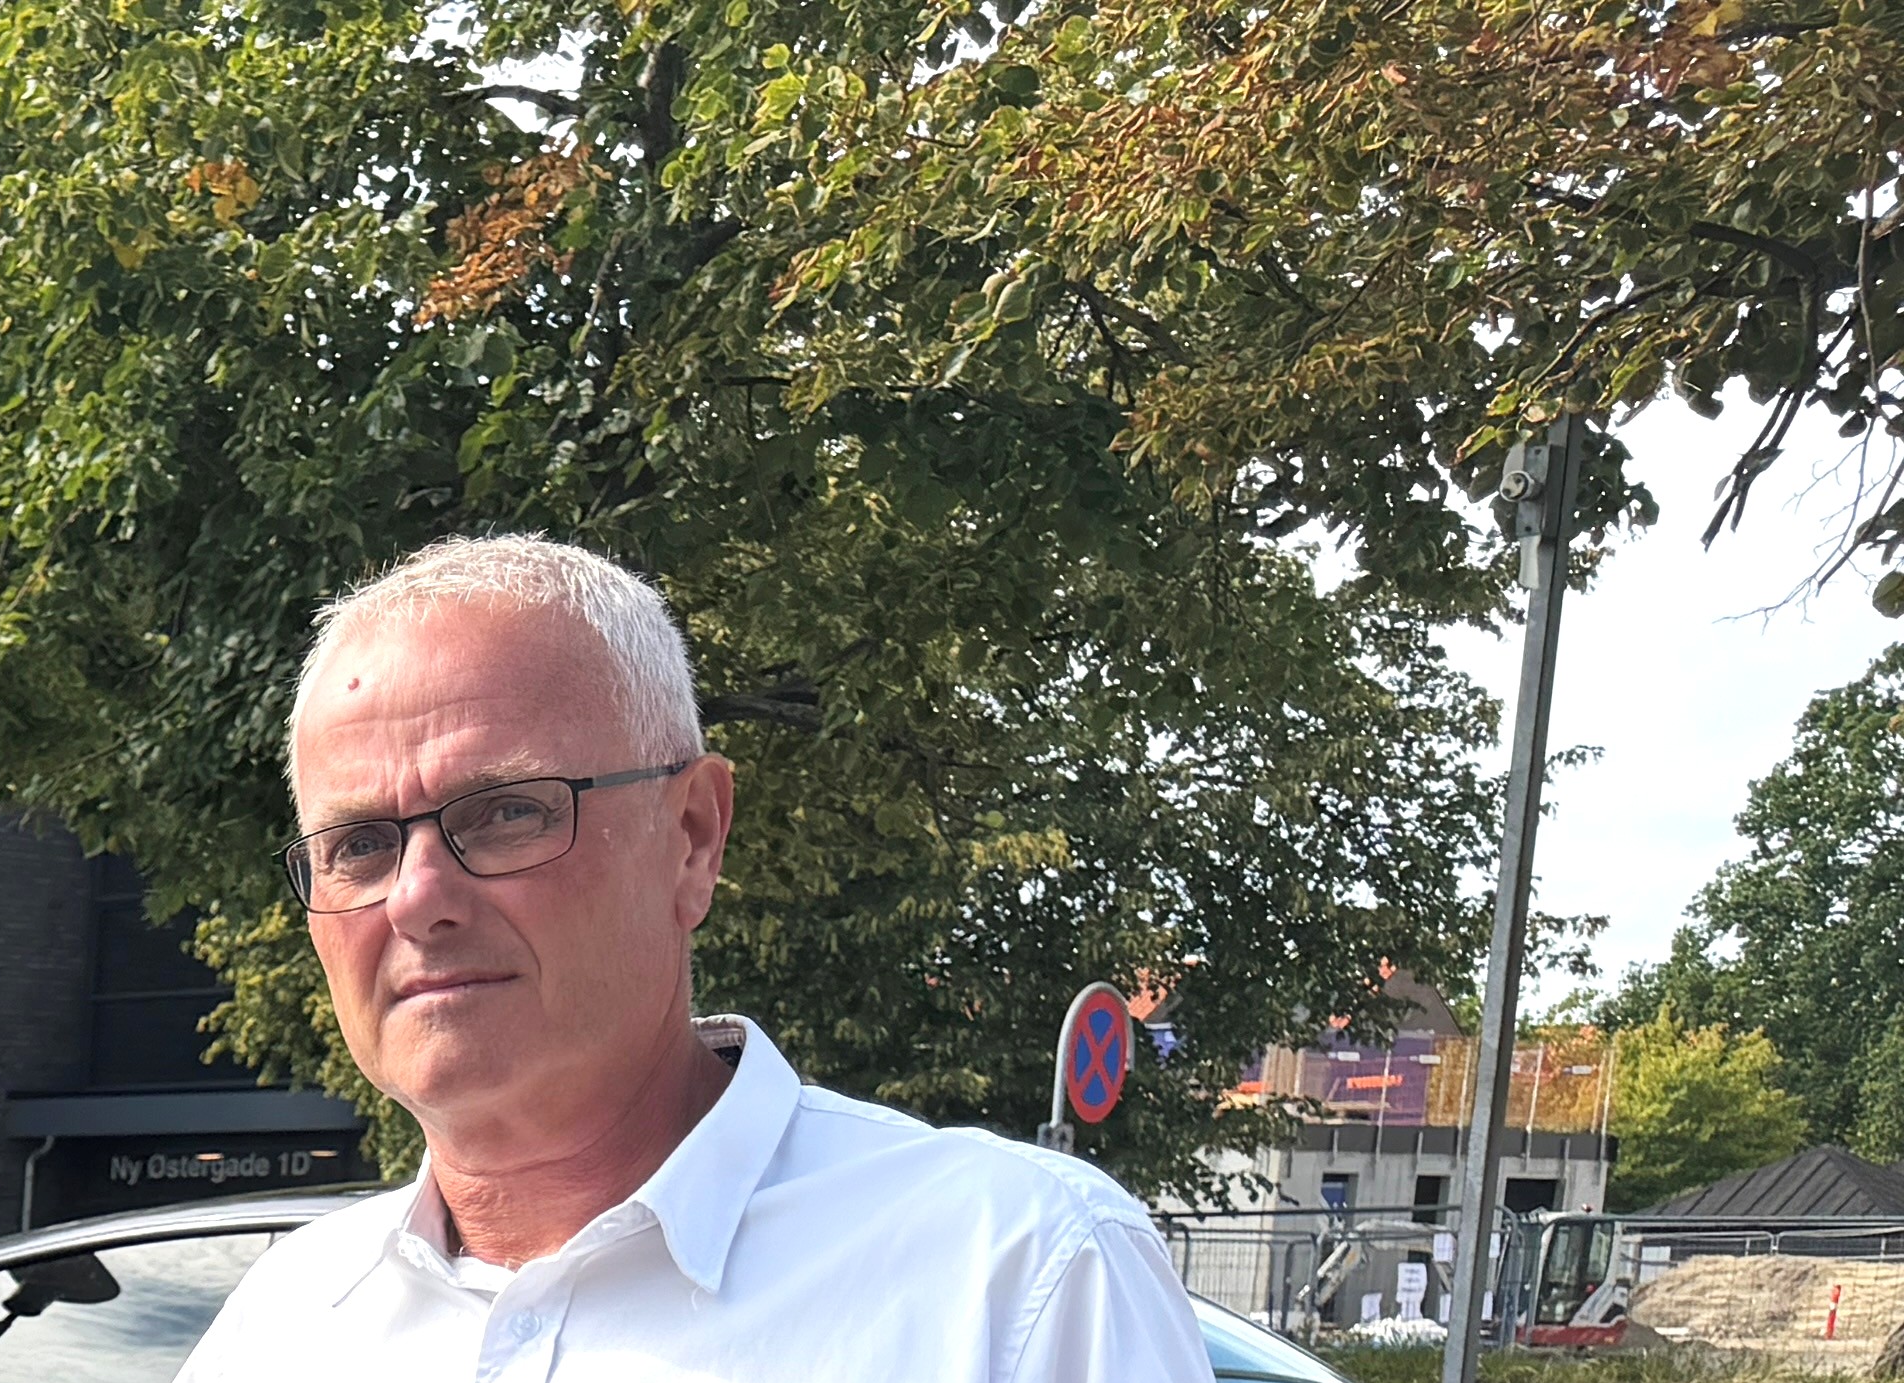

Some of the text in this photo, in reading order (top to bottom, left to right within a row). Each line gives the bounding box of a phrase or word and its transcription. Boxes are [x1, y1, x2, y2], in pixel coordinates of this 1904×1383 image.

[109, 1151, 311, 1186] Ny Østergade 1D
